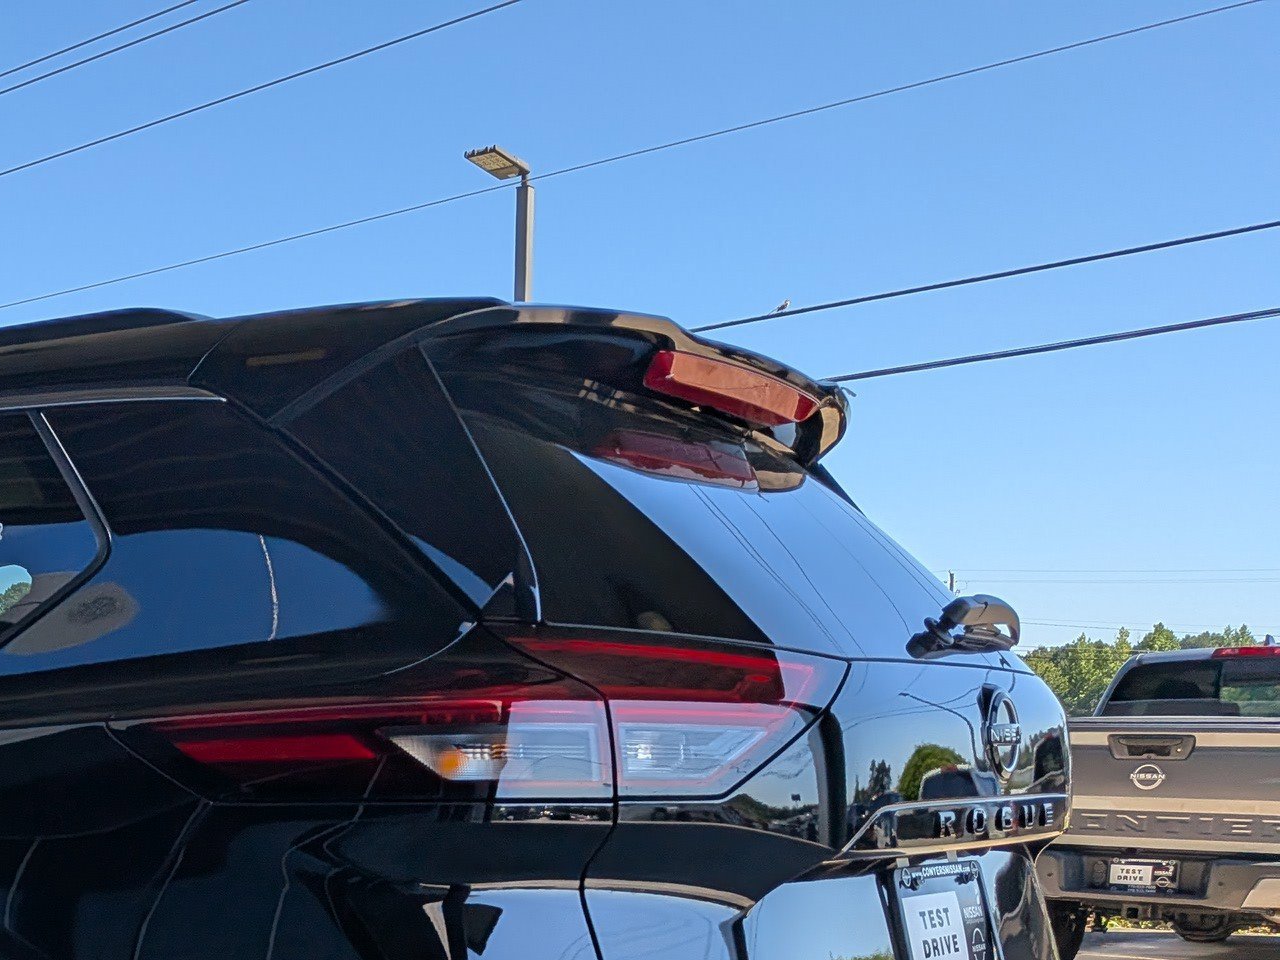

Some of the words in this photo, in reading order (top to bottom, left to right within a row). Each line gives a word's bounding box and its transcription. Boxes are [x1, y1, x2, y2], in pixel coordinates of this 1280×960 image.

[938, 802, 1054, 838] ROGUE
[919, 907, 951, 930] TEST
[922, 934, 960, 959] DRIVE
